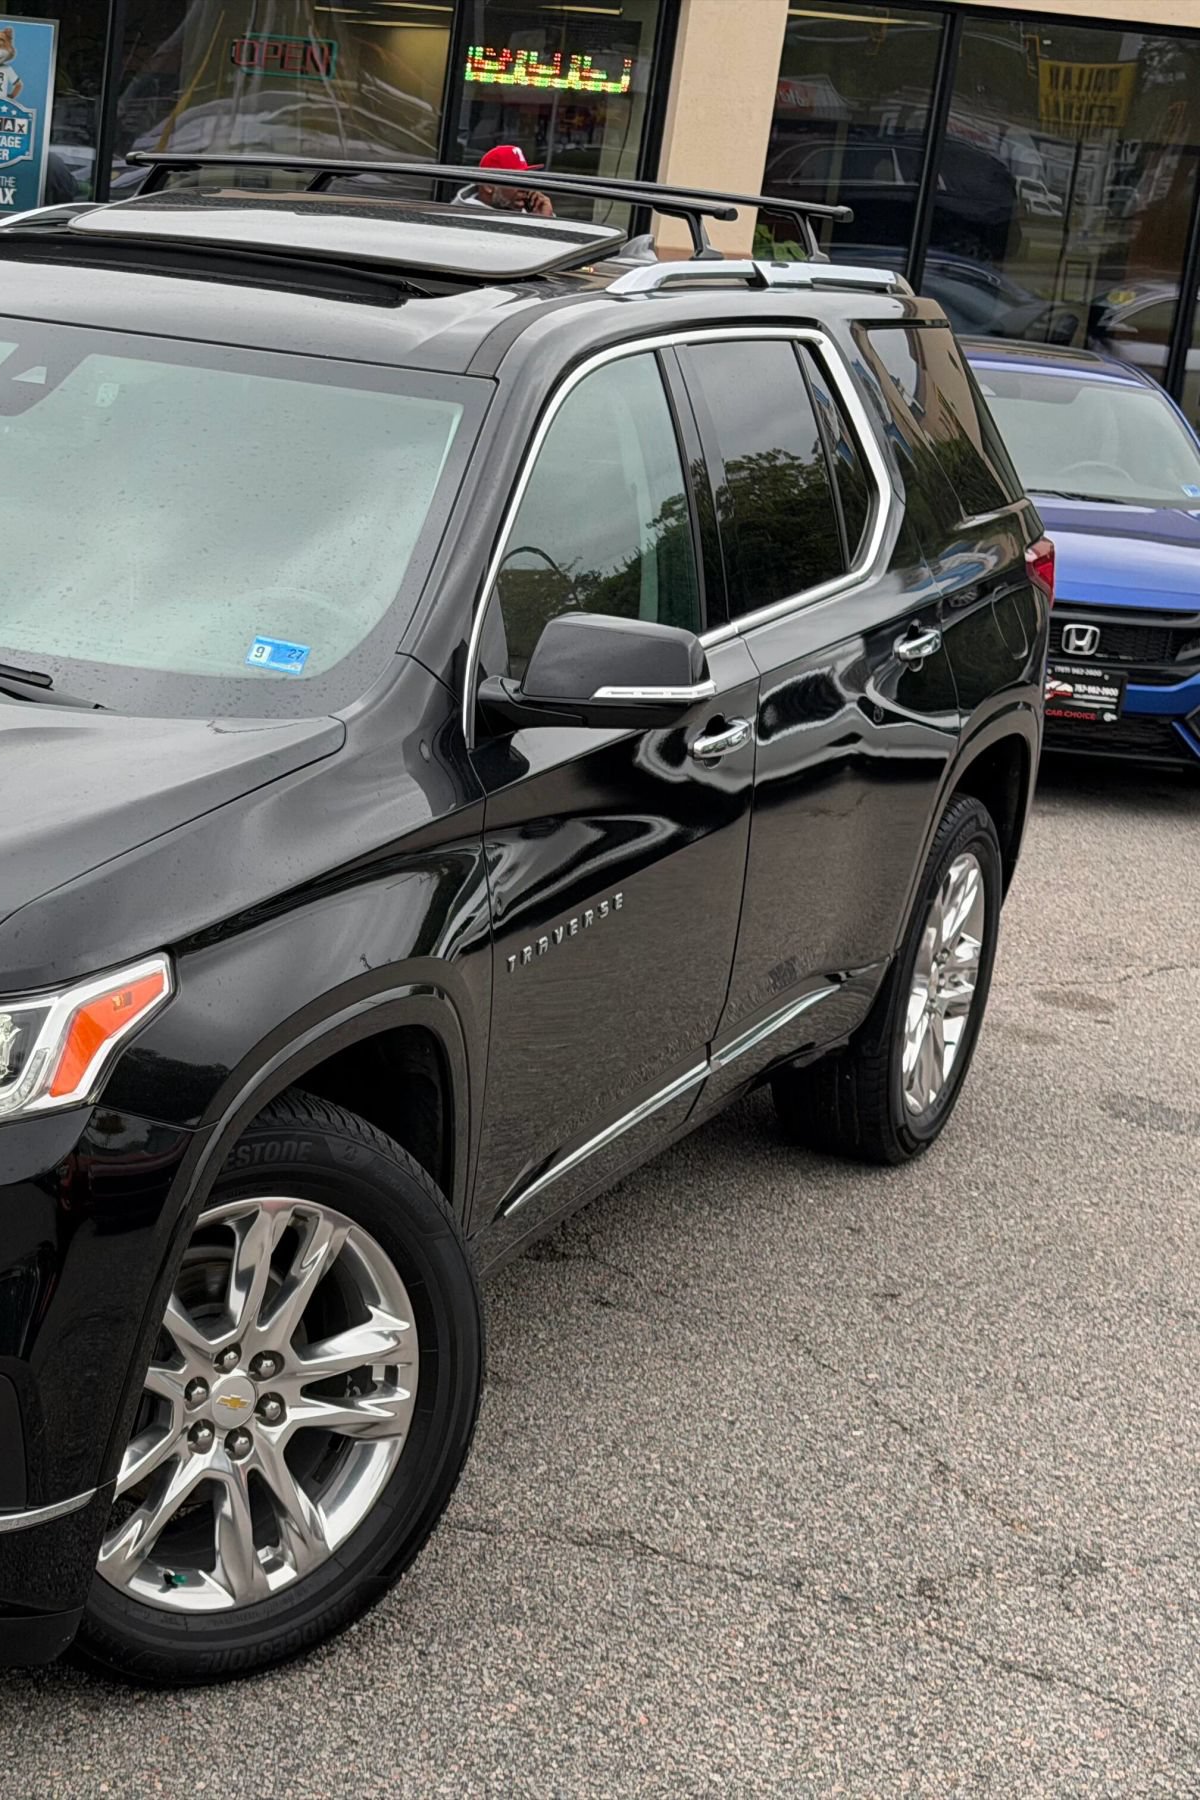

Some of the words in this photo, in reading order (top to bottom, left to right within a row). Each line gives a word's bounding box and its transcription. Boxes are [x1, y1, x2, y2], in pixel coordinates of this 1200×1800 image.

[234, 39, 331, 74] OPEN
[0, 175, 17, 187] THE
[254, 646, 266, 658] 9
[506, 892, 623, 973] TRAVERSE
